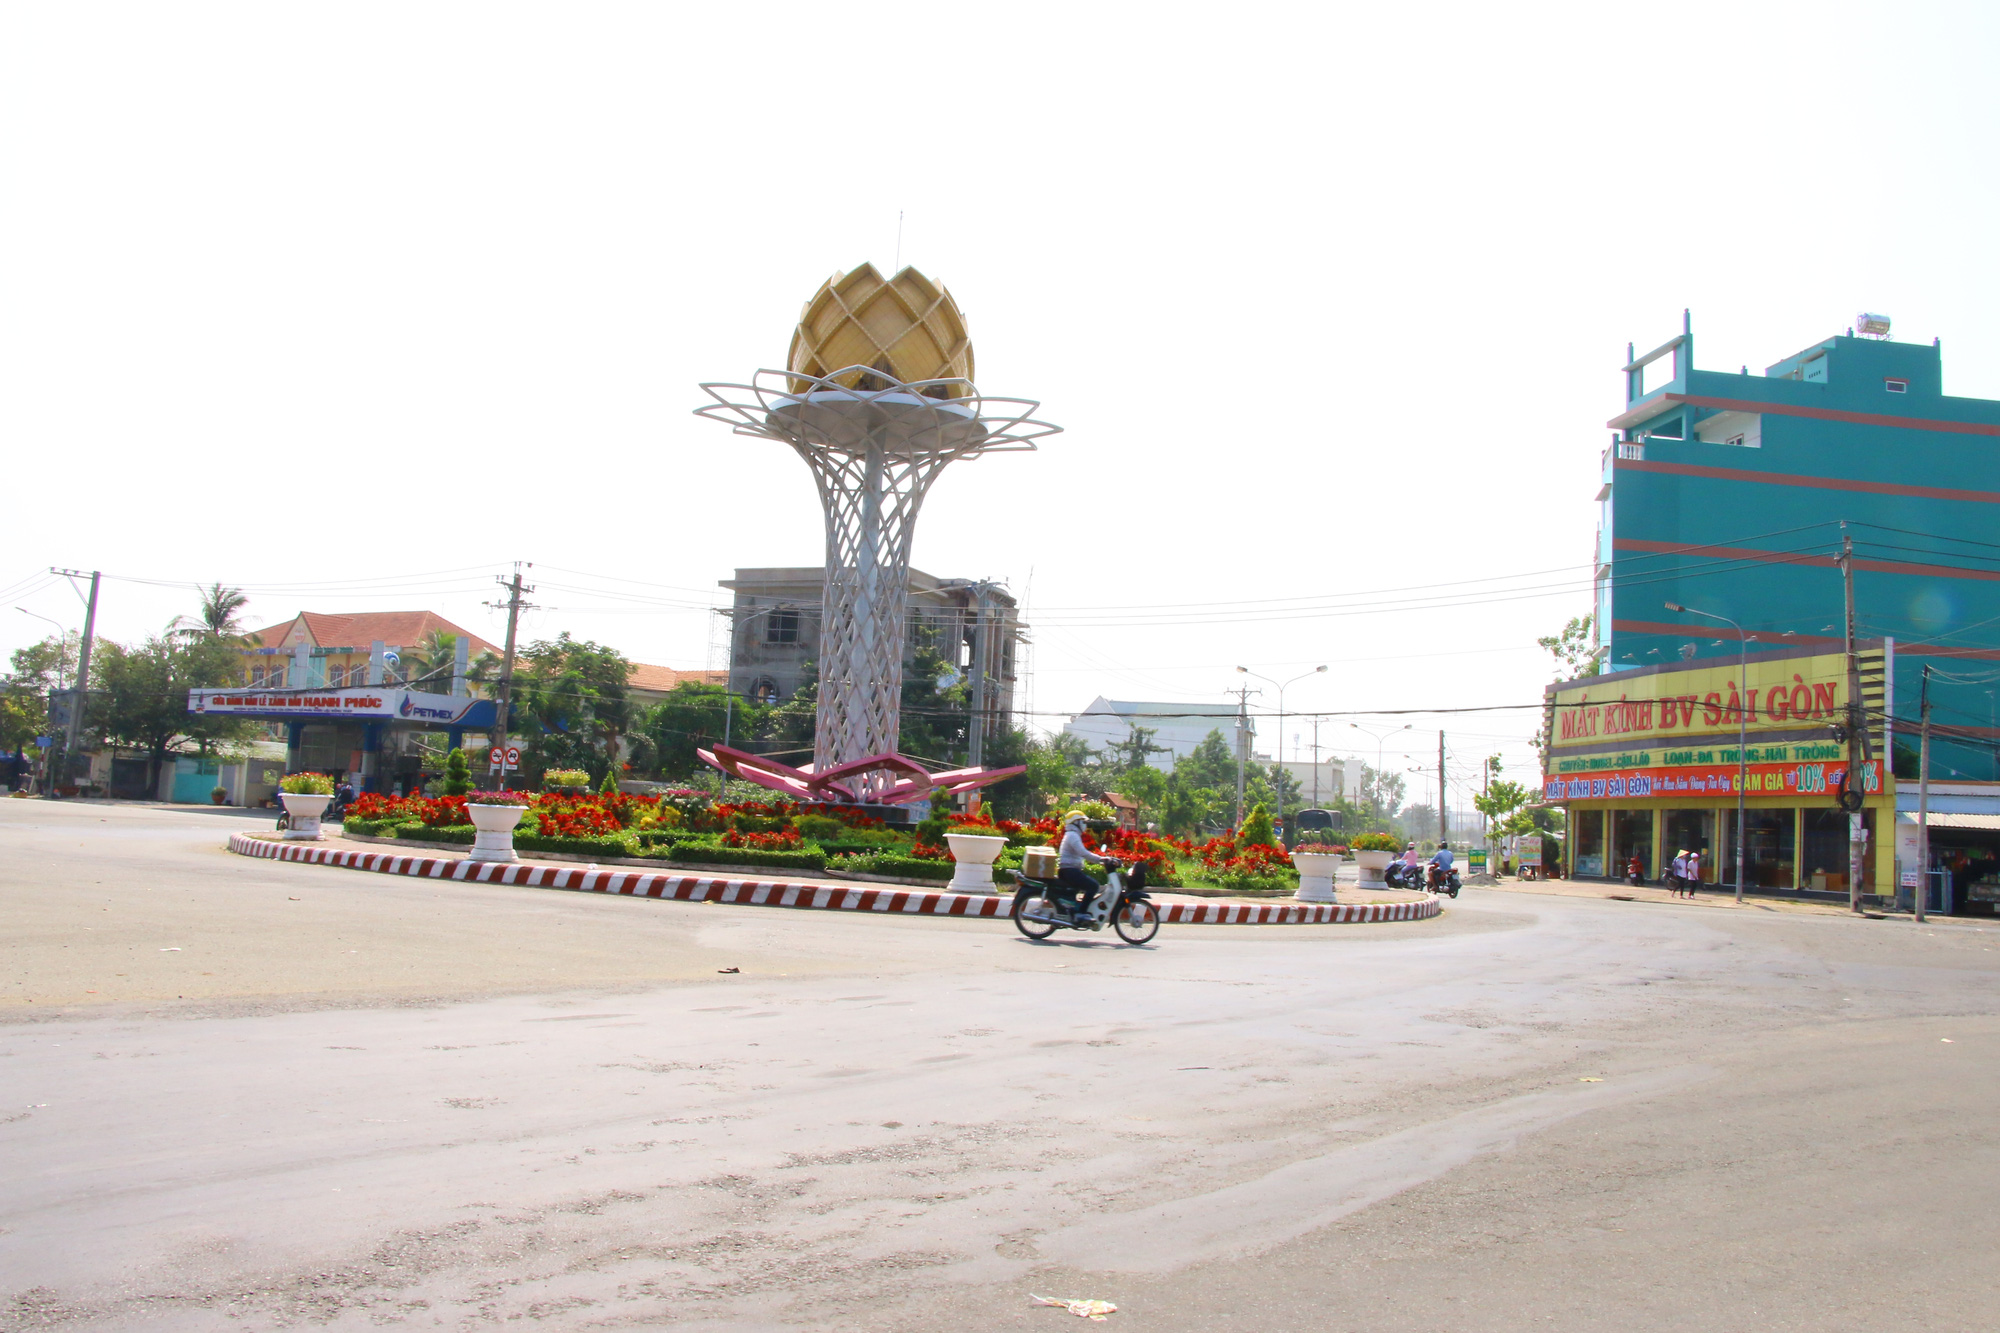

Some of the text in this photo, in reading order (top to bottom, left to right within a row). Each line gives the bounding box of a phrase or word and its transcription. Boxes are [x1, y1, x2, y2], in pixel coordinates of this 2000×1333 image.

[344, 694, 382, 708] PHÚC
[413, 707, 453, 719] PETIMEX
[1603, 693, 1654, 735] KÍNH
[1658, 695, 1698, 729] BV
[1703, 681, 1758, 726] SÀI
[1766, 673, 1837, 721] GÒN
[1567, 777, 1590, 798] KÍNH
[1592, 778, 1606, 797] BV
[1608, 774, 1625, 797] SÀI
[1628, 772, 1651, 795] GÒN
[1765, 768, 1784, 790] GIÁ
[1797, 763, 1825, 793] 10%
